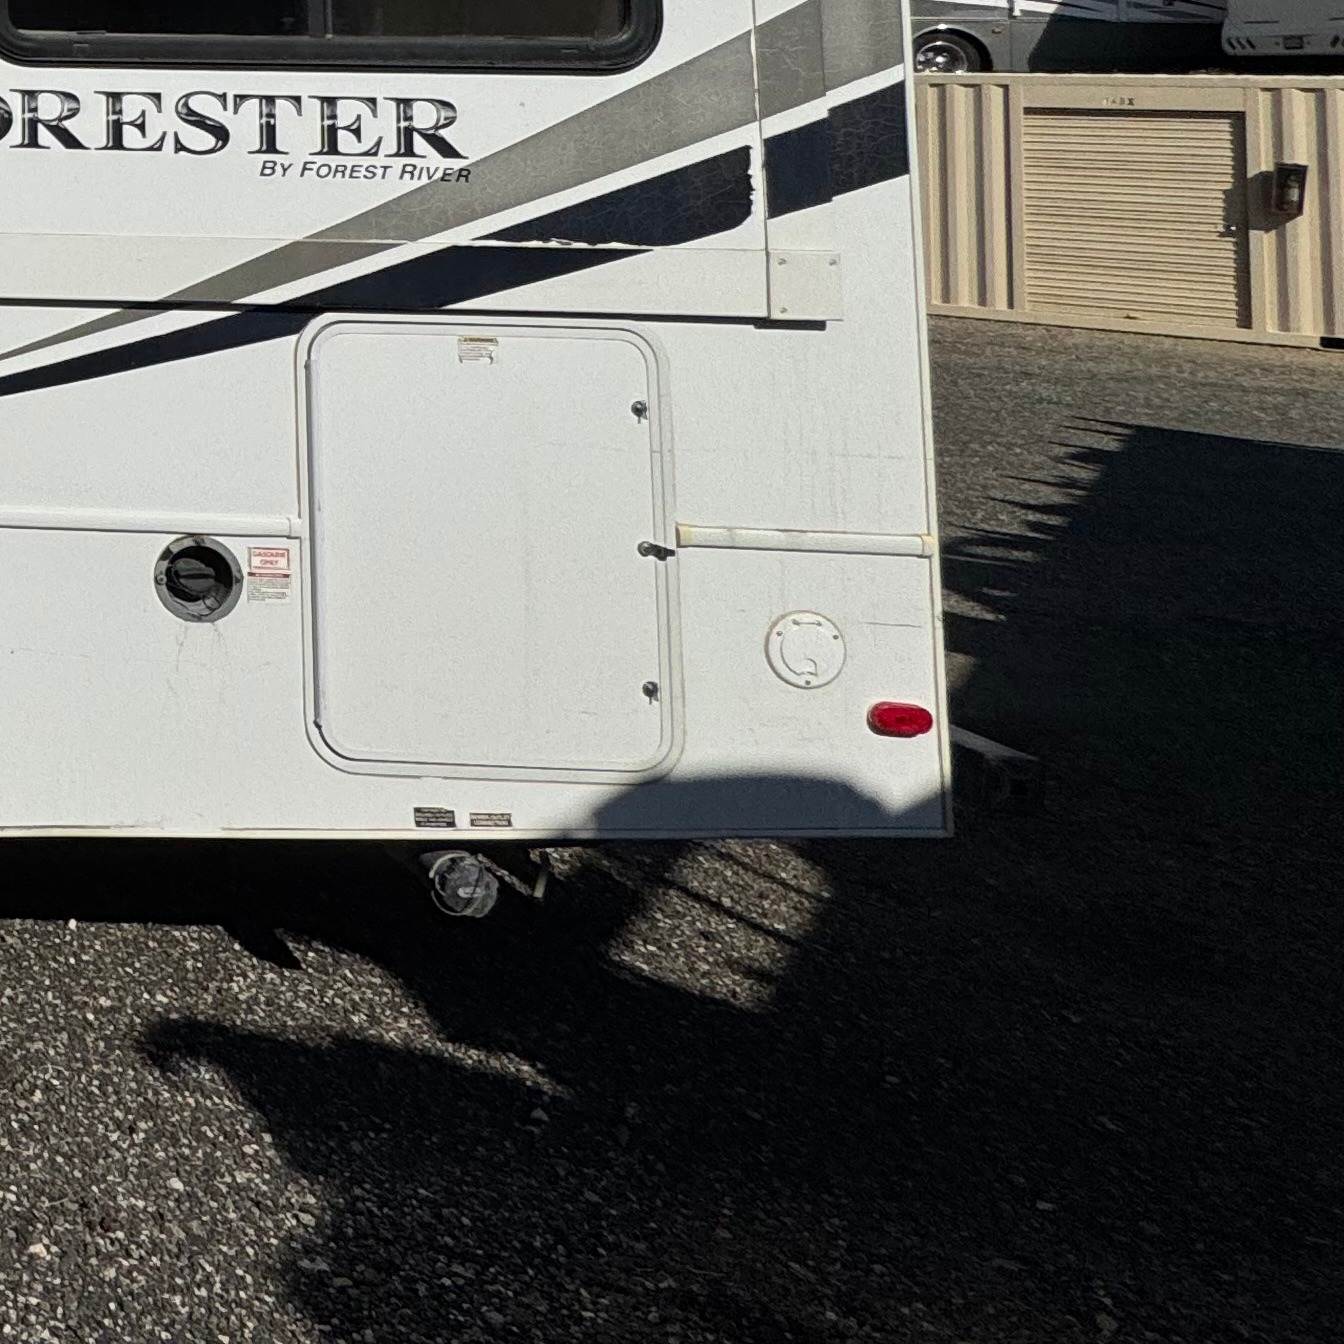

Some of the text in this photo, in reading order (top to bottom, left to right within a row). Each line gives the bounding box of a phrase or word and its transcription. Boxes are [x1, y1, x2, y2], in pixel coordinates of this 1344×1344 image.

[259, 160, 472, 184] BY FOREST RIVER
